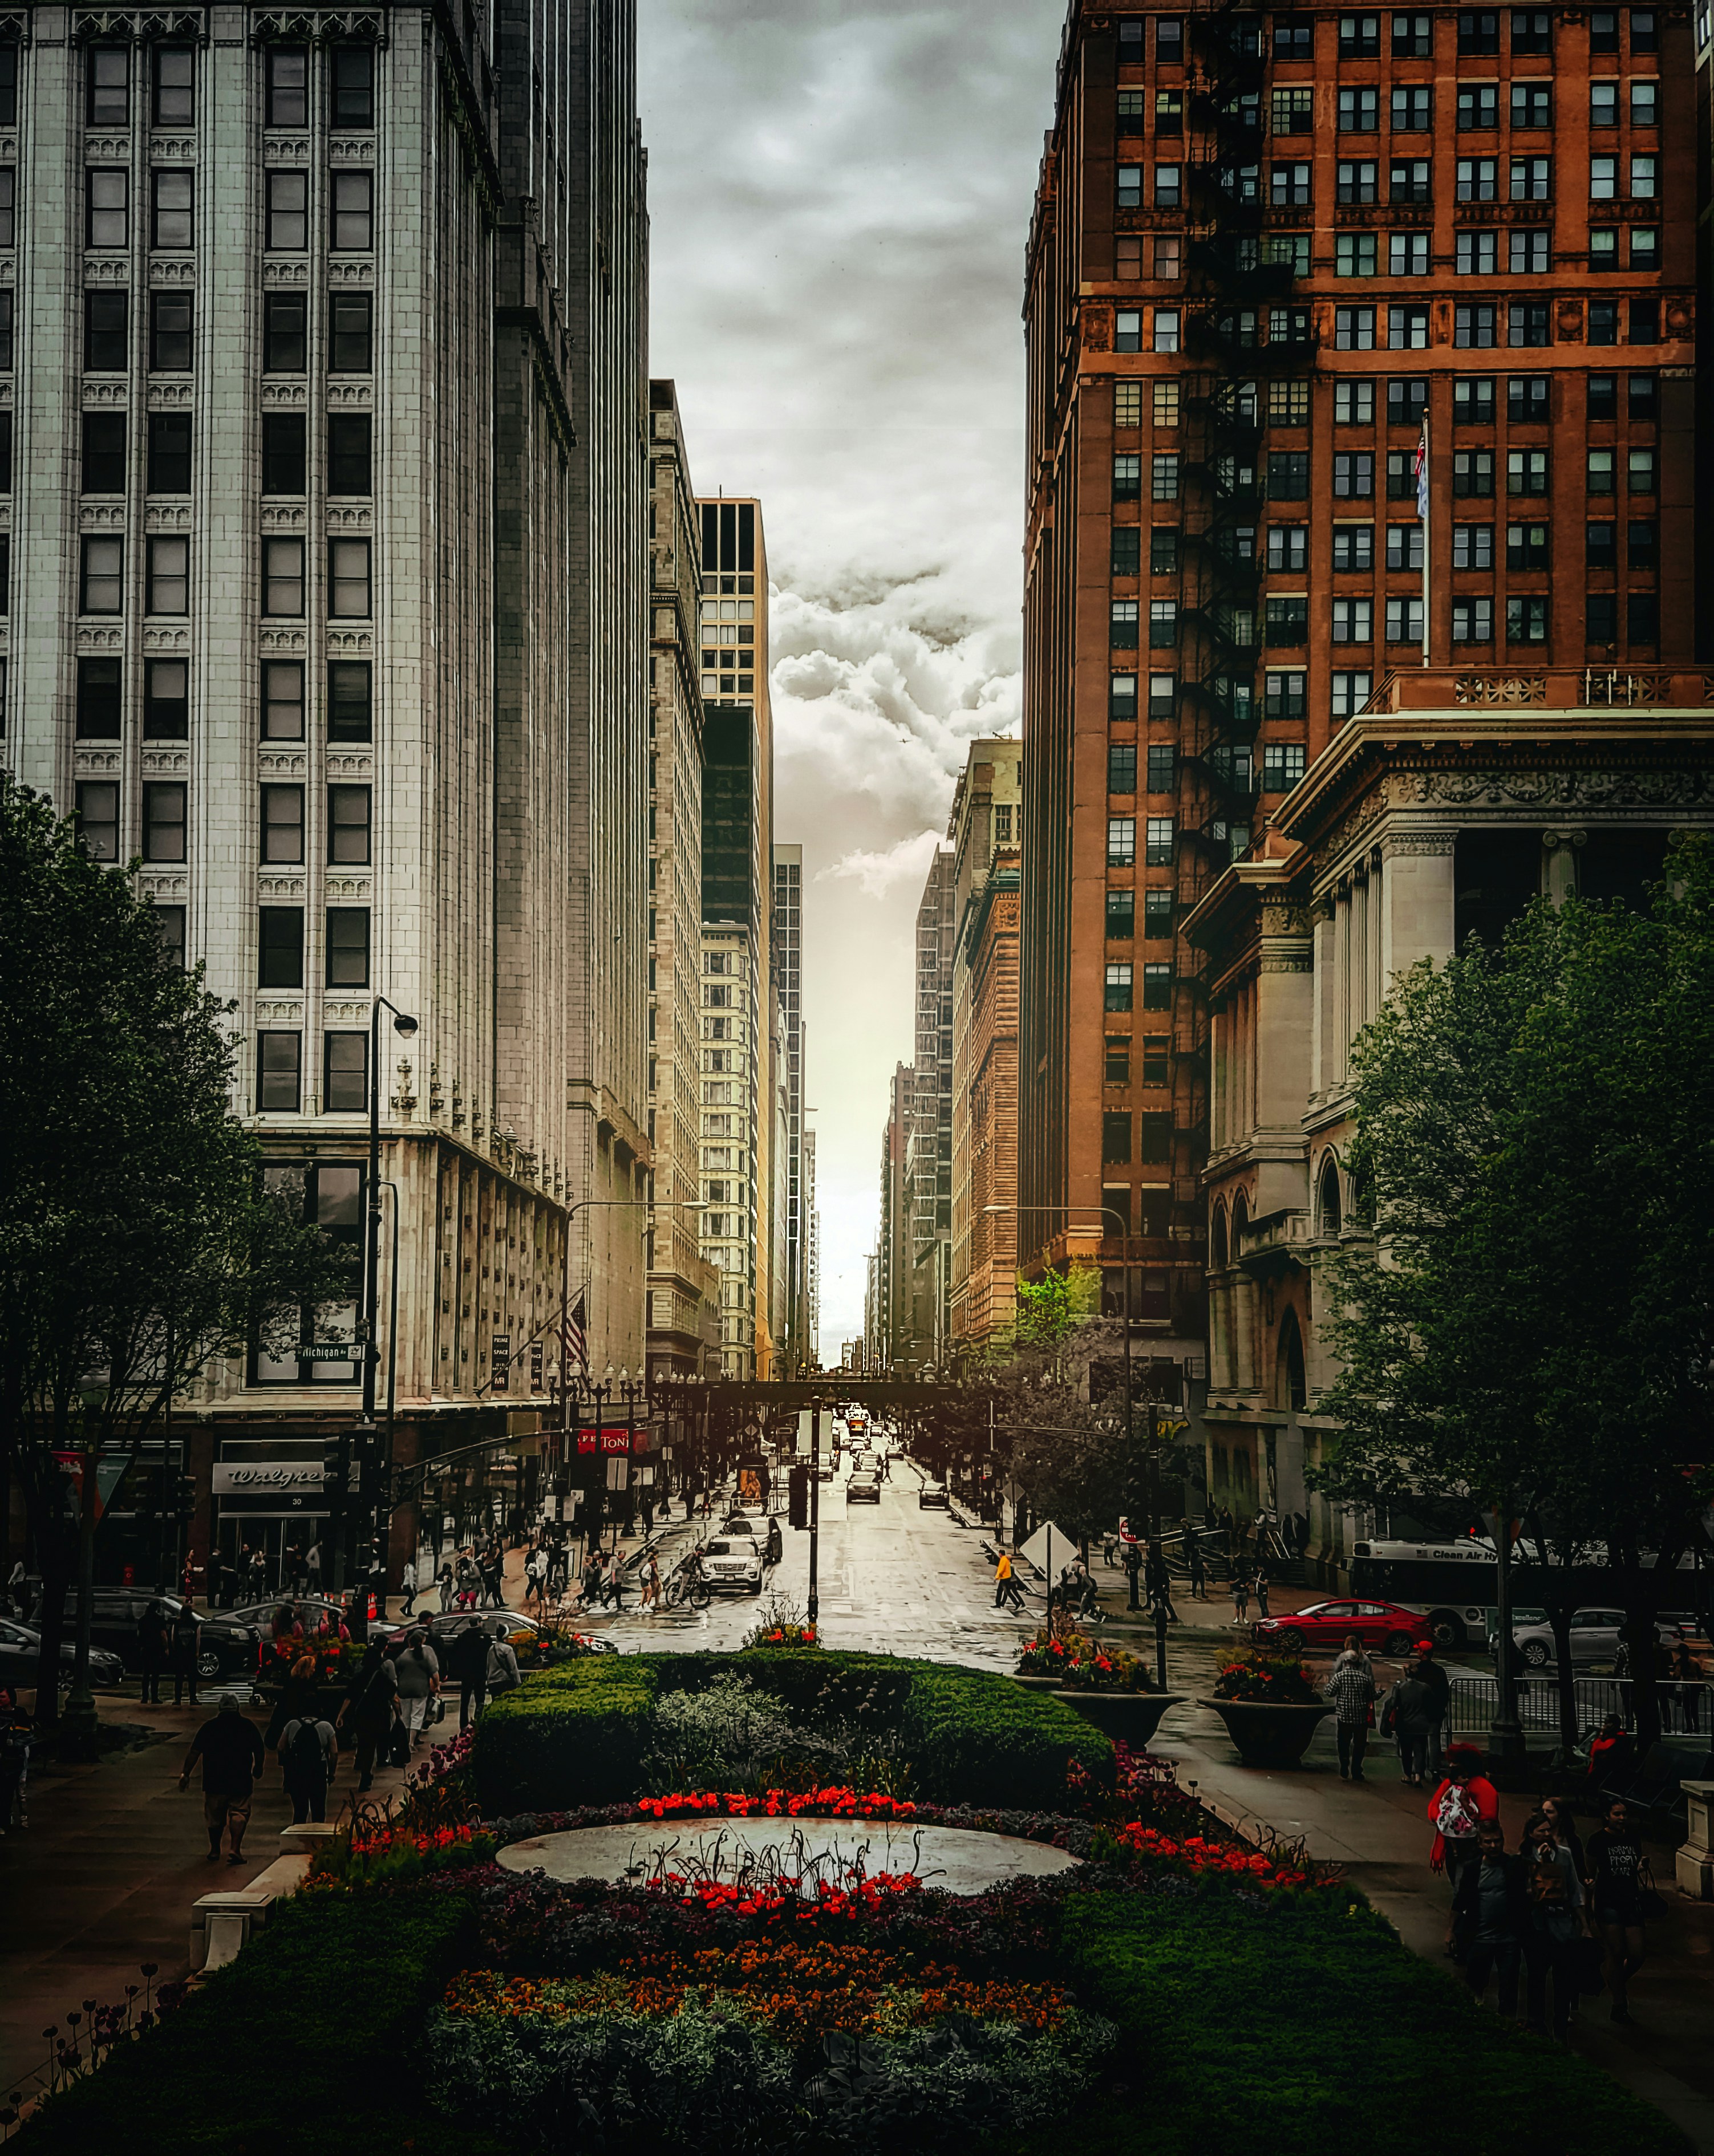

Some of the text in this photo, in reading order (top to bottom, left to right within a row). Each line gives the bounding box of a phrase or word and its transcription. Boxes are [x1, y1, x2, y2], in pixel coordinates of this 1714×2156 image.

[229, 1468, 359, 1489] Walgre
[1433, 1550, 1463, 1560] Clean
[1465, 1552, 1482, 1560] Air
